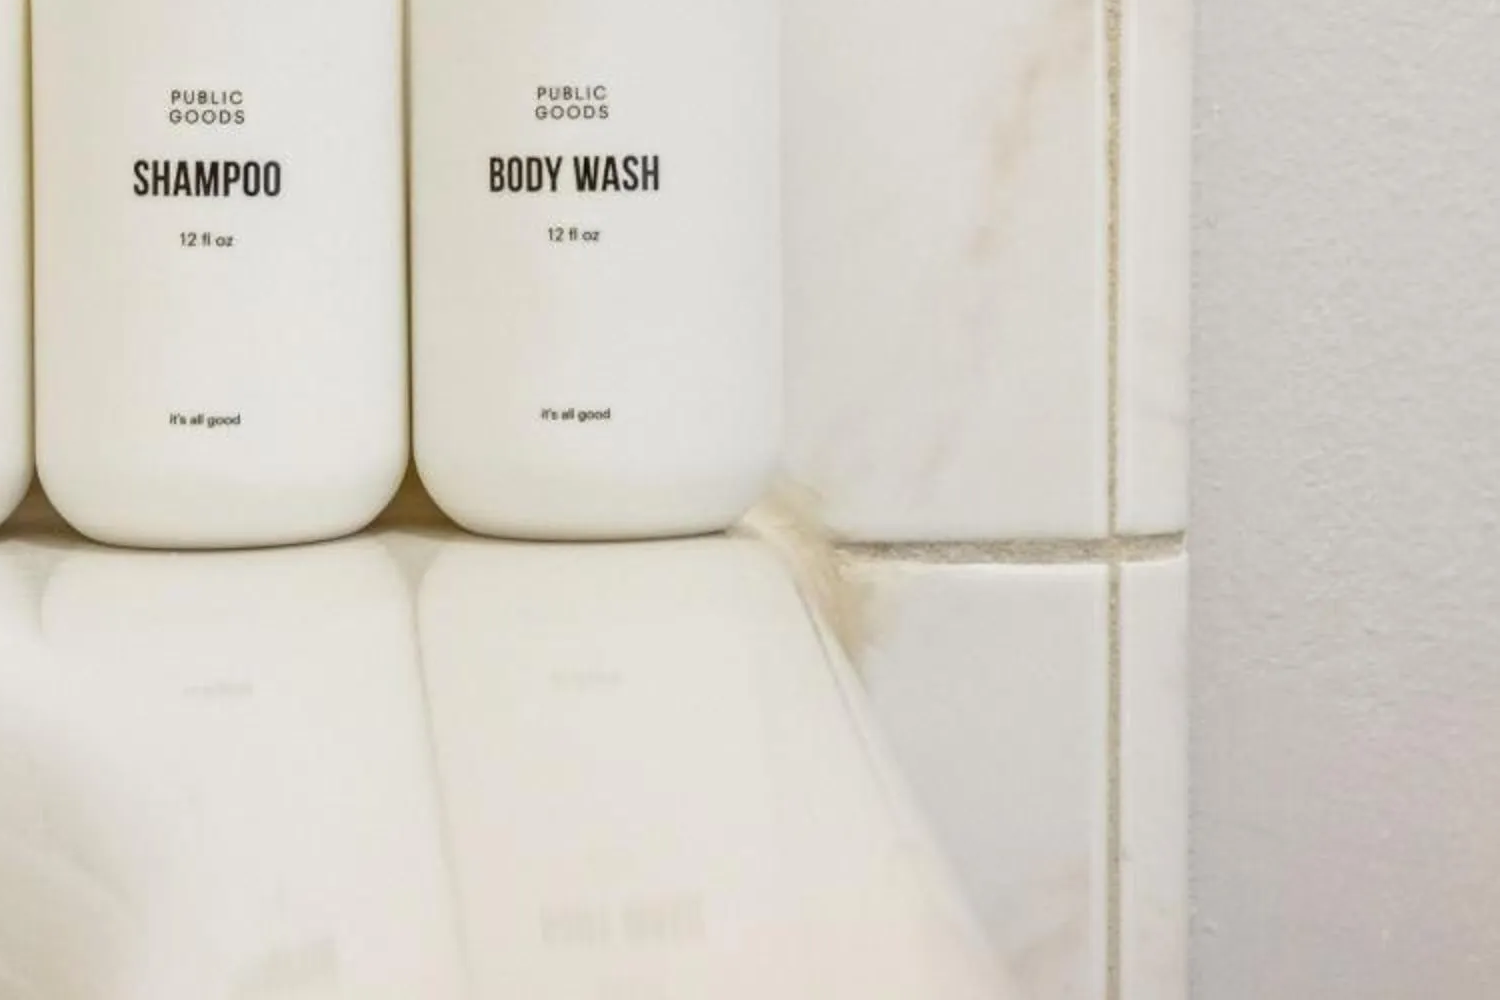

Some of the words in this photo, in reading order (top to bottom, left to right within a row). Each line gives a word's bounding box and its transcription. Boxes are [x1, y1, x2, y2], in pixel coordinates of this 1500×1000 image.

[171, 89, 243, 105] PUBLIC
[536, 85, 607, 101] PUBLIC
[169, 109, 245, 125] GOODS
[535, 104, 609, 121] GOODS
[133, 159, 282, 198] SHAMPOO
[489, 155, 563, 193] BODY
[573, 154, 661, 193] WASH
[180, 231, 197, 247] 12
[201, 231, 211, 247] fl
[215, 235, 234, 247] oz
[547, 226, 565, 242] 12
[568, 227, 579, 241] fl
[581, 230, 601, 242] oz
[169, 412, 187, 425] it's
[189, 412, 205, 425] all
[206, 411, 241, 428] good
[540, 407, 559, 420] it's
[561, 407, 576, 420] all
[577, 407, 612, 423] good
